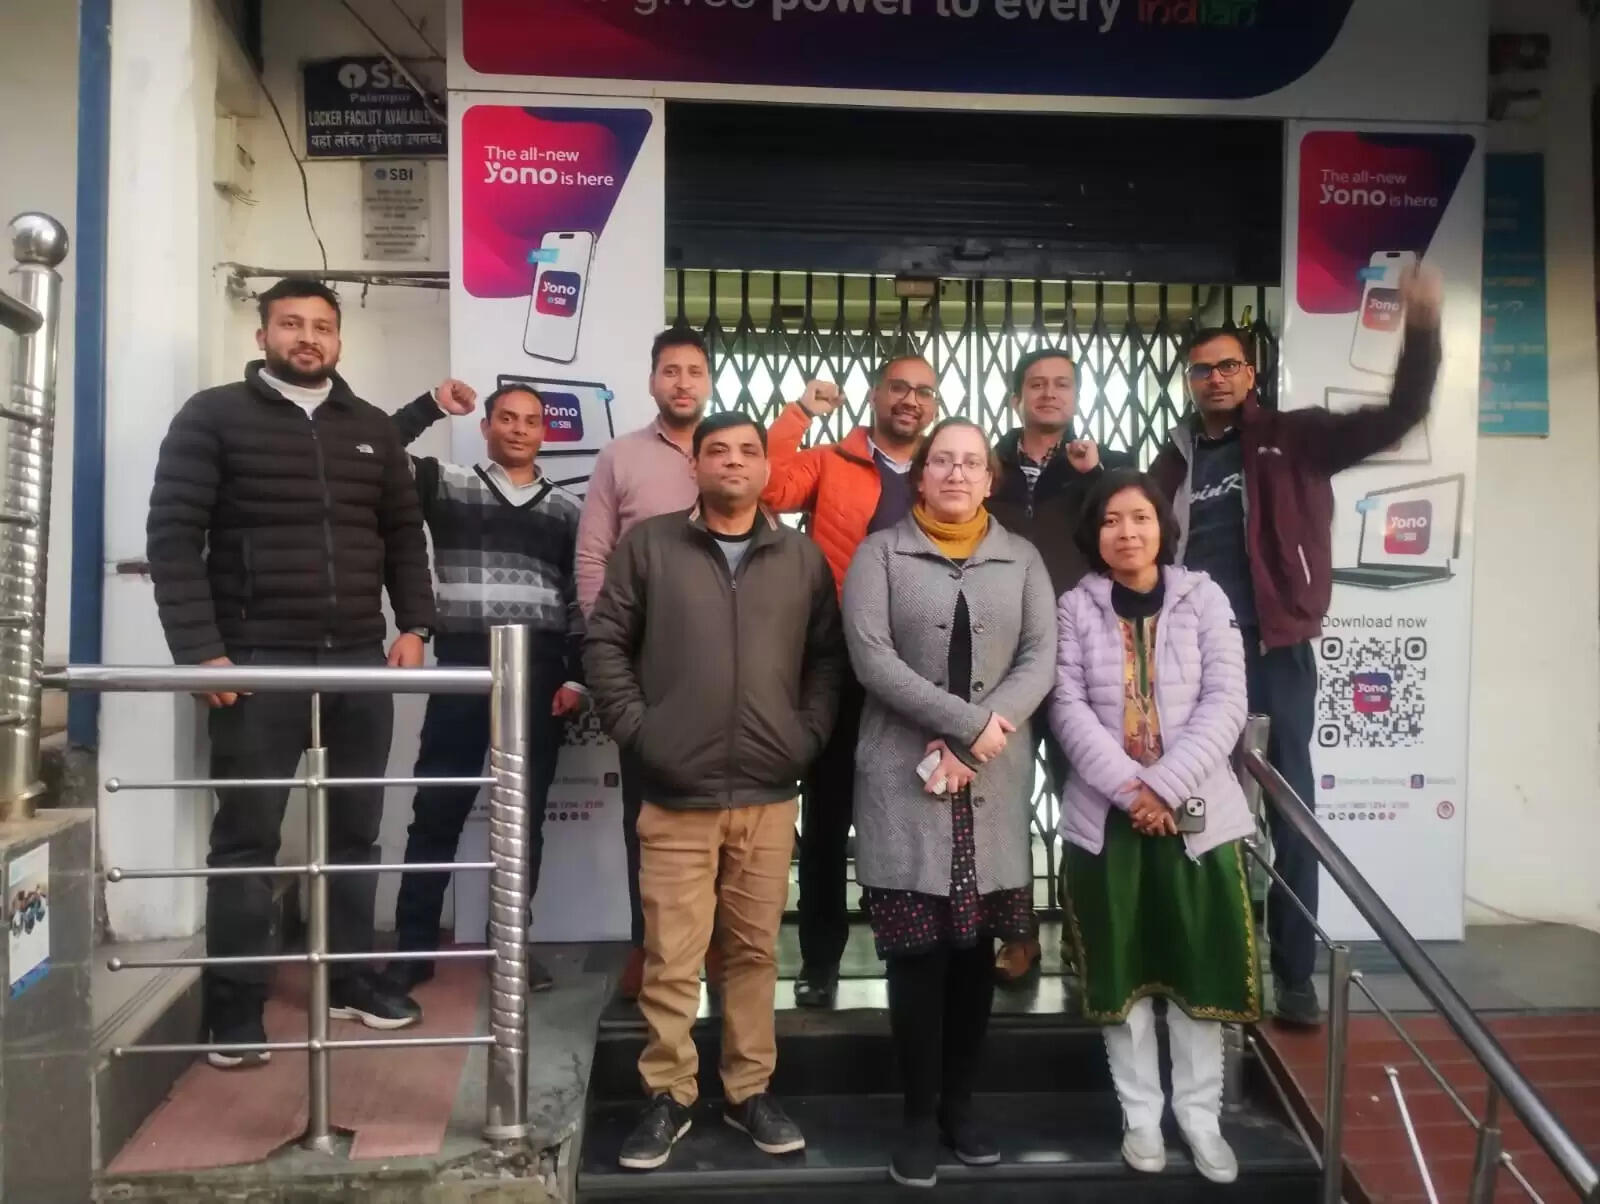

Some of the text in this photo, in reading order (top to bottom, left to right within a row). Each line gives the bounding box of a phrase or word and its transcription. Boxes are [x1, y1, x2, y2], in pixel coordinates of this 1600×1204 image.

[994, 0, 1121, 33] every
[308, 110, 342, 126] LOCKER
[345, 109, 382, 126] FACILITY
[484, 146, 579, 162] The all-new
[389, 168, 413, 181] SBI
[561, 172, 574, 185] is
[577, 173, 614, 186] here
[1320, 169, 1407, 185] The all-new
[1389, 193, 1401, 206] is
[1404, 194, 1438, 208] here
[559, 421, 572, 429] SBI
[1322, 614, 1428, 628] Download now
